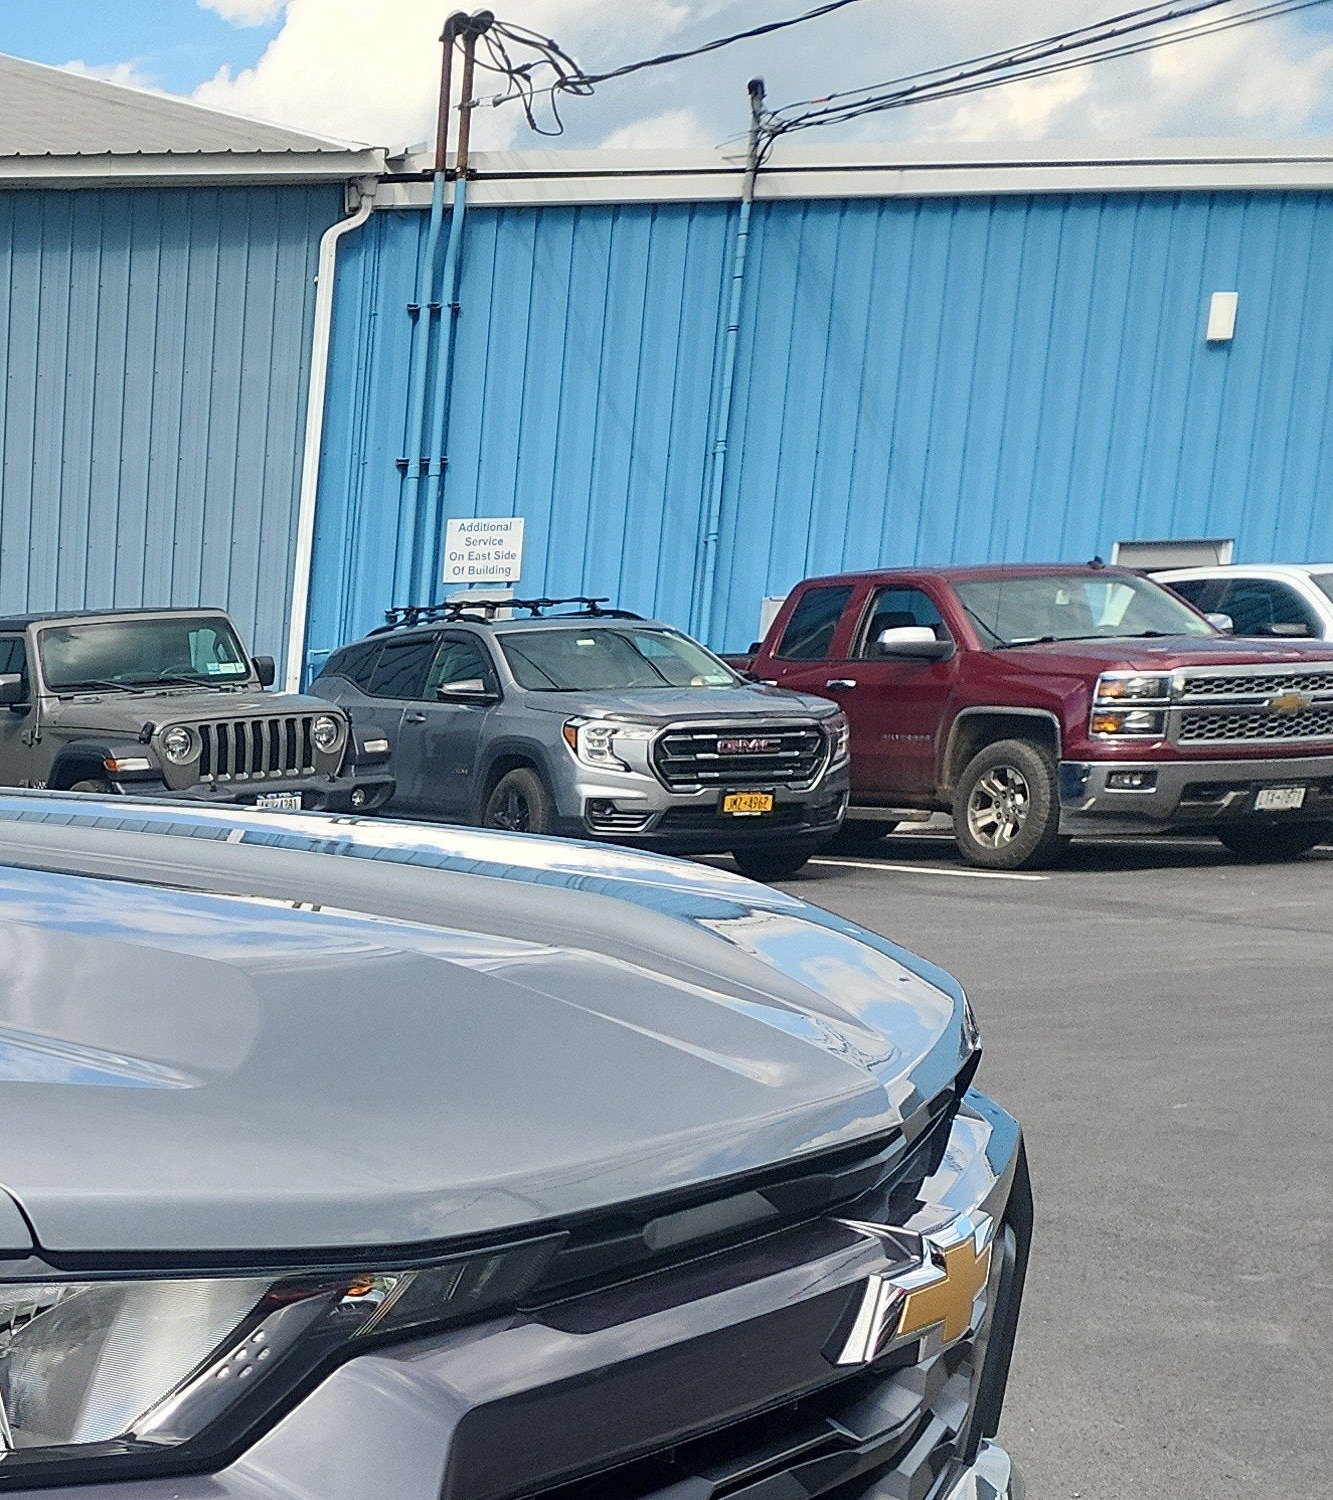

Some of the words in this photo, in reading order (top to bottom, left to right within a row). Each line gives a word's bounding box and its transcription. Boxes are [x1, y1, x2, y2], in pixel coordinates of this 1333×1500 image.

[459, 522, 512, 532] Additional
[465, 536, 504, 546] Service
[449, 551, 464, 561] On
[468, 551, 491, 561] East
[494, 550, 517, 560] Side
[452, 565, 465, 575] Of
[468, 565, 511, 577] Building
[717, 738, 781, 754] GMC
